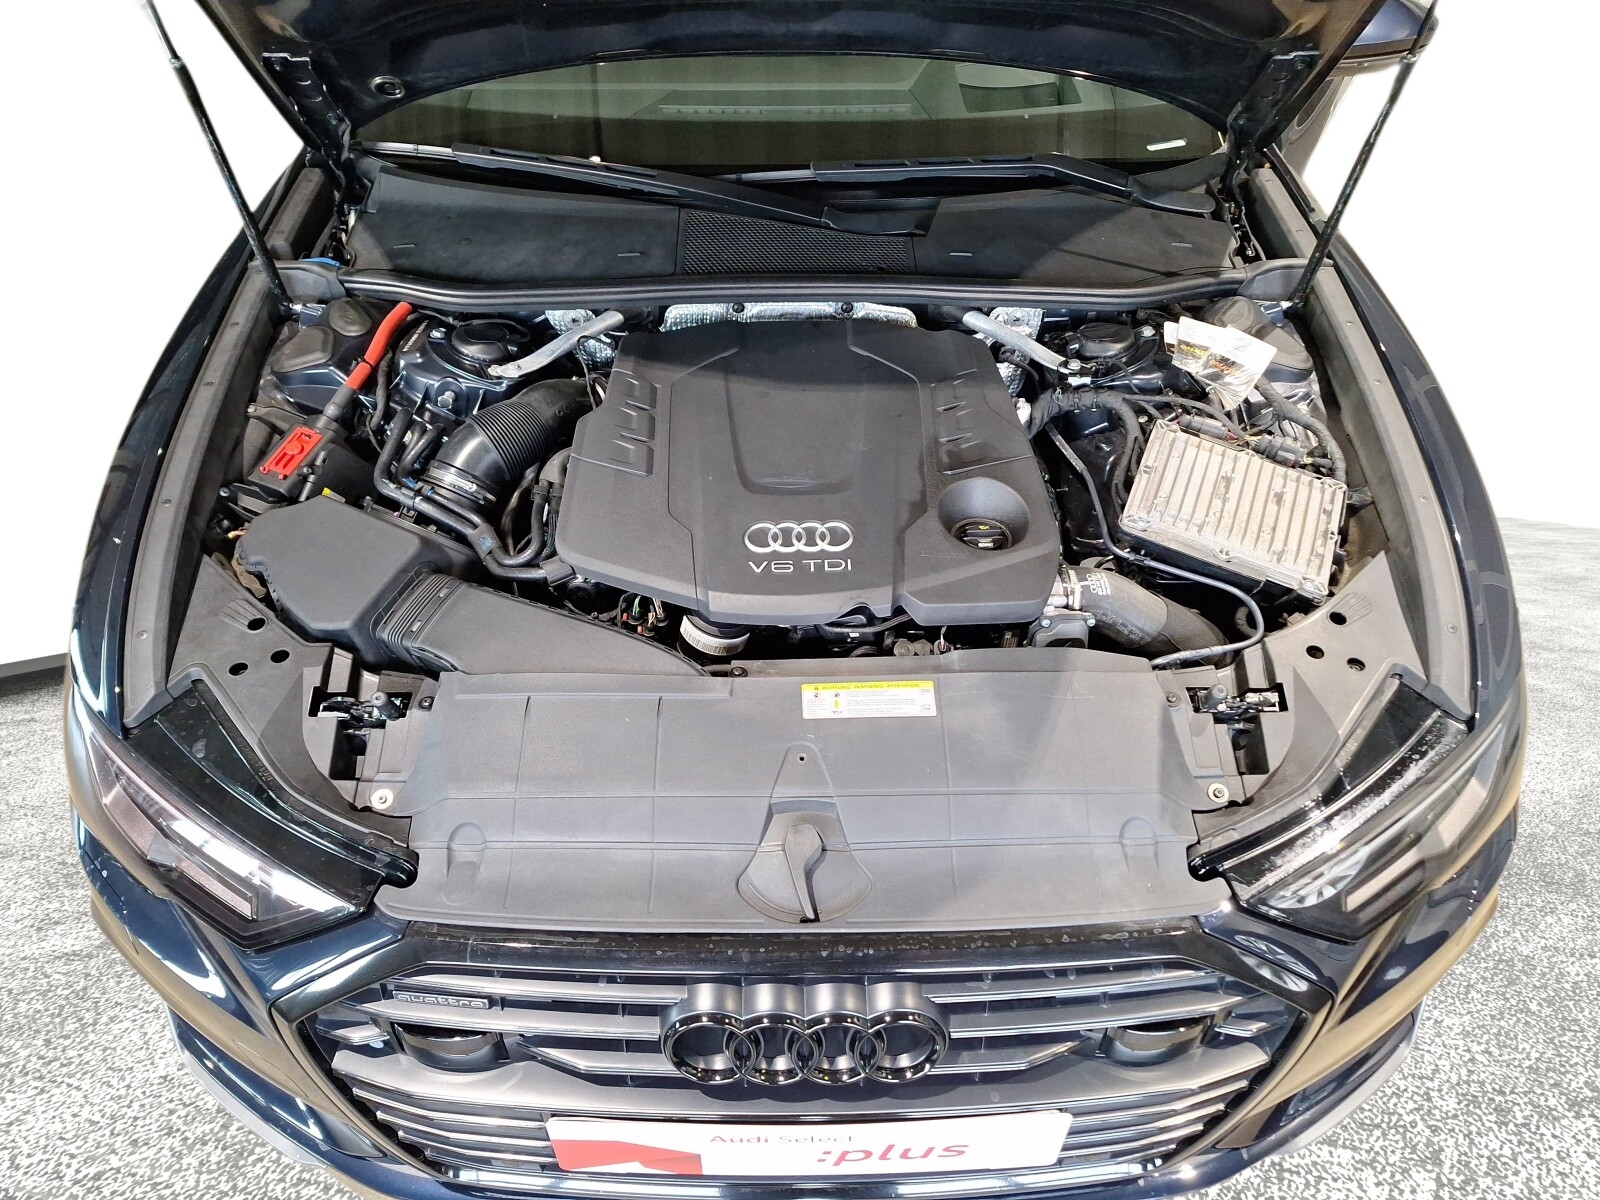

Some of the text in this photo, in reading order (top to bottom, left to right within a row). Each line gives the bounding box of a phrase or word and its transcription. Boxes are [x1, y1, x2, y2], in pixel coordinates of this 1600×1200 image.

[748, 559, 852, 573] V6 TDI
[397, 994, 484, 1008] quattro
[710, 1135, 854, 1143] Audi Select
